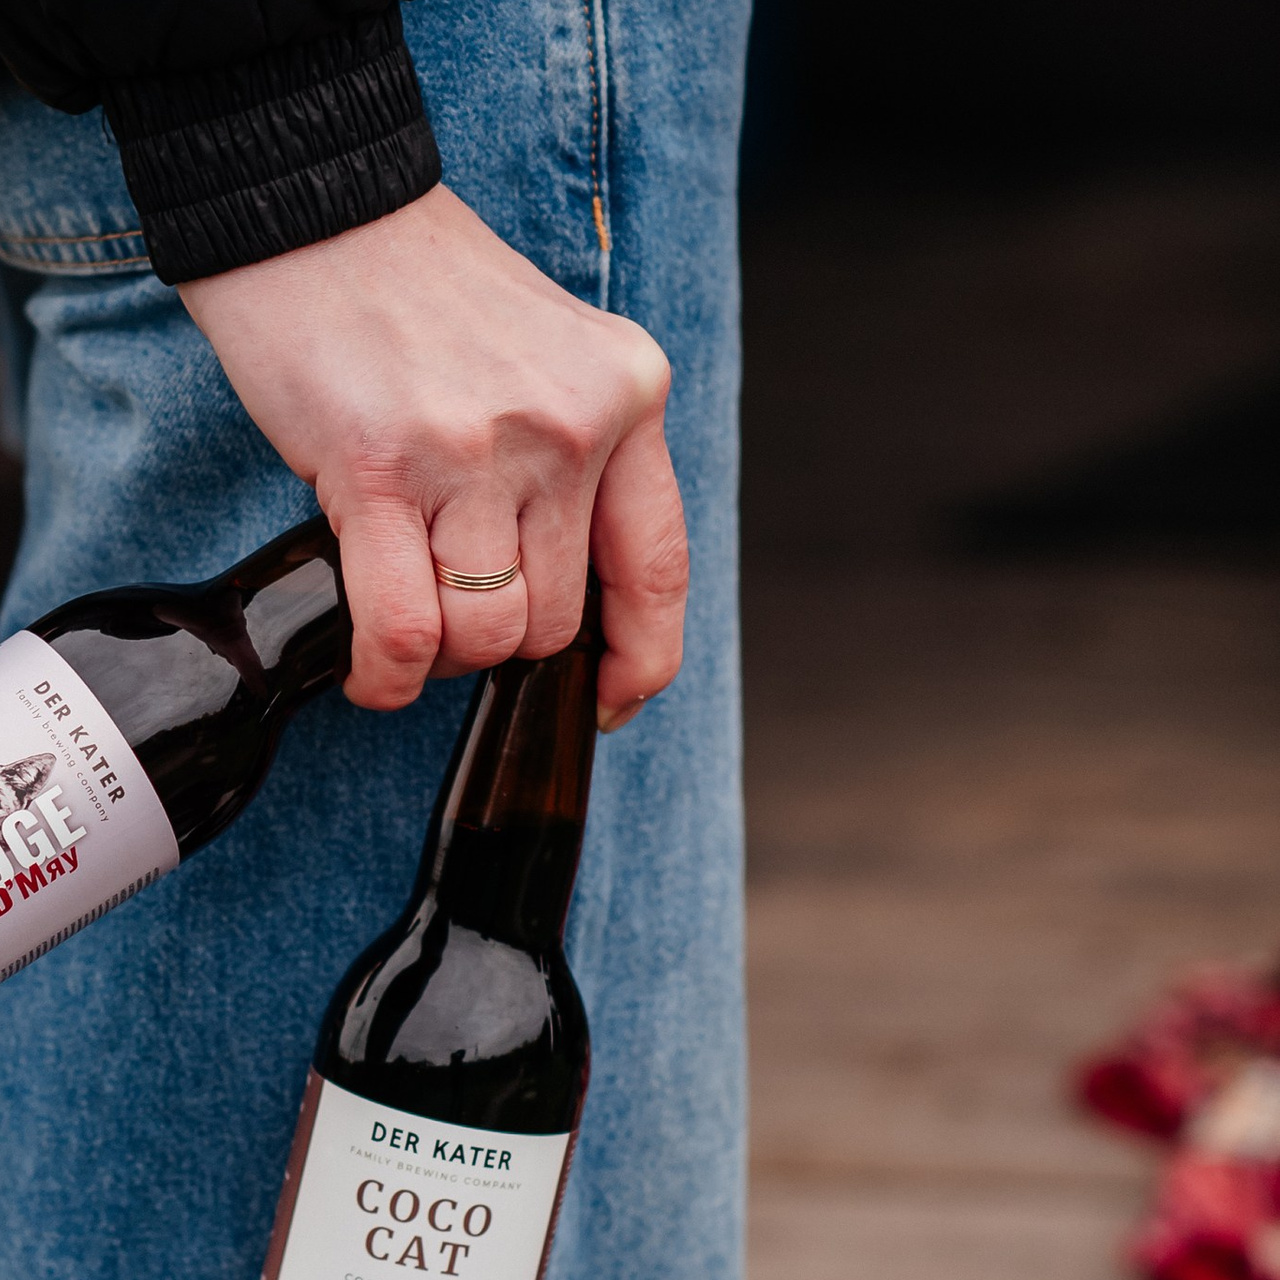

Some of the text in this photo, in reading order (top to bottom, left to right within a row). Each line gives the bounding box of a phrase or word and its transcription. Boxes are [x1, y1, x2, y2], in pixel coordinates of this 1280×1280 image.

[15, 688, 110, 822] family brewing company
[33, 680, 125, 804] DER KATER
[349, 1145, 523, 1191] FAMILY BREWING COMPANY
[370, 1121, 512, 1171] DER KATER
[356, 1179, 492, 1238] COCO
[365, 1226, 470, 1277] CAT
